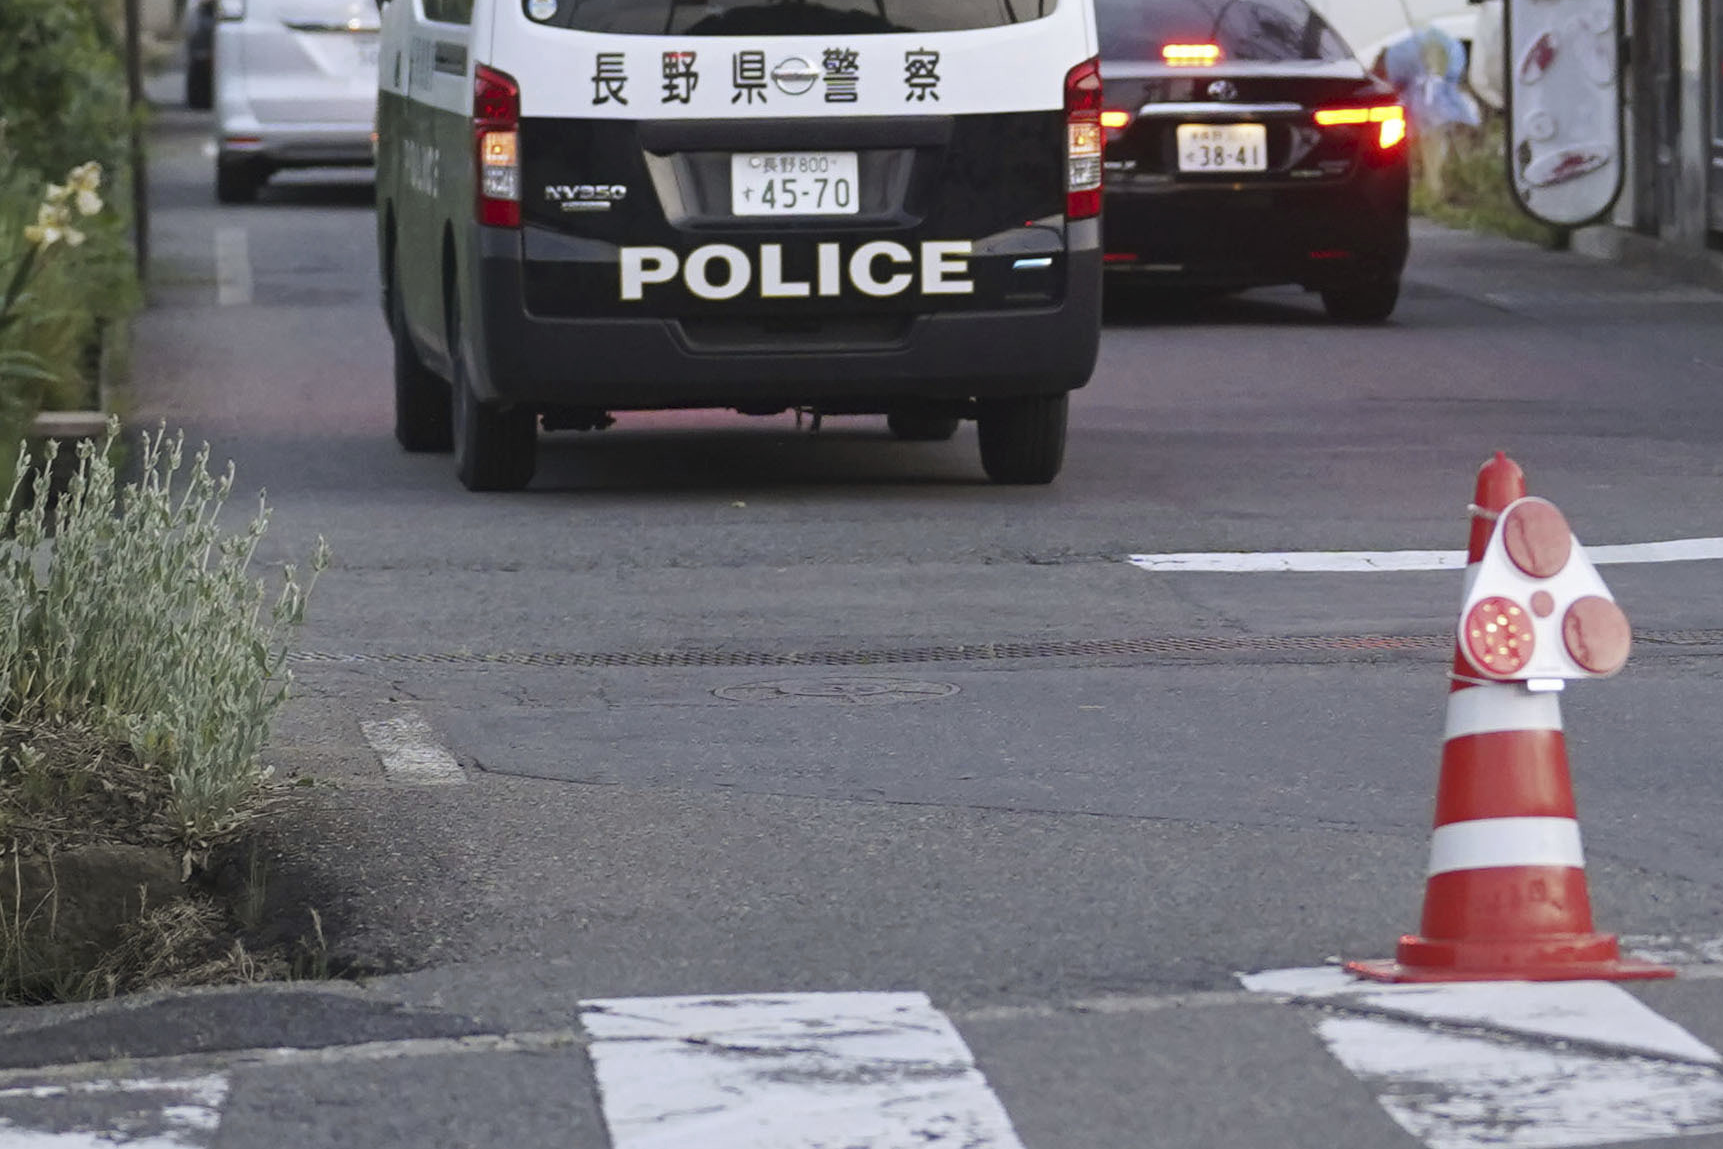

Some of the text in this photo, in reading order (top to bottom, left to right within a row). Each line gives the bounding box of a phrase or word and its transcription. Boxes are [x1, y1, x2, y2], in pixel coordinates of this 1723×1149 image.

[590, 47, 942, 106] 長野県警察
[544, 185, 627, 200] NV350
[761, 178, 850, 209] 45-70
[619, 240, 976, 302] POLICE
